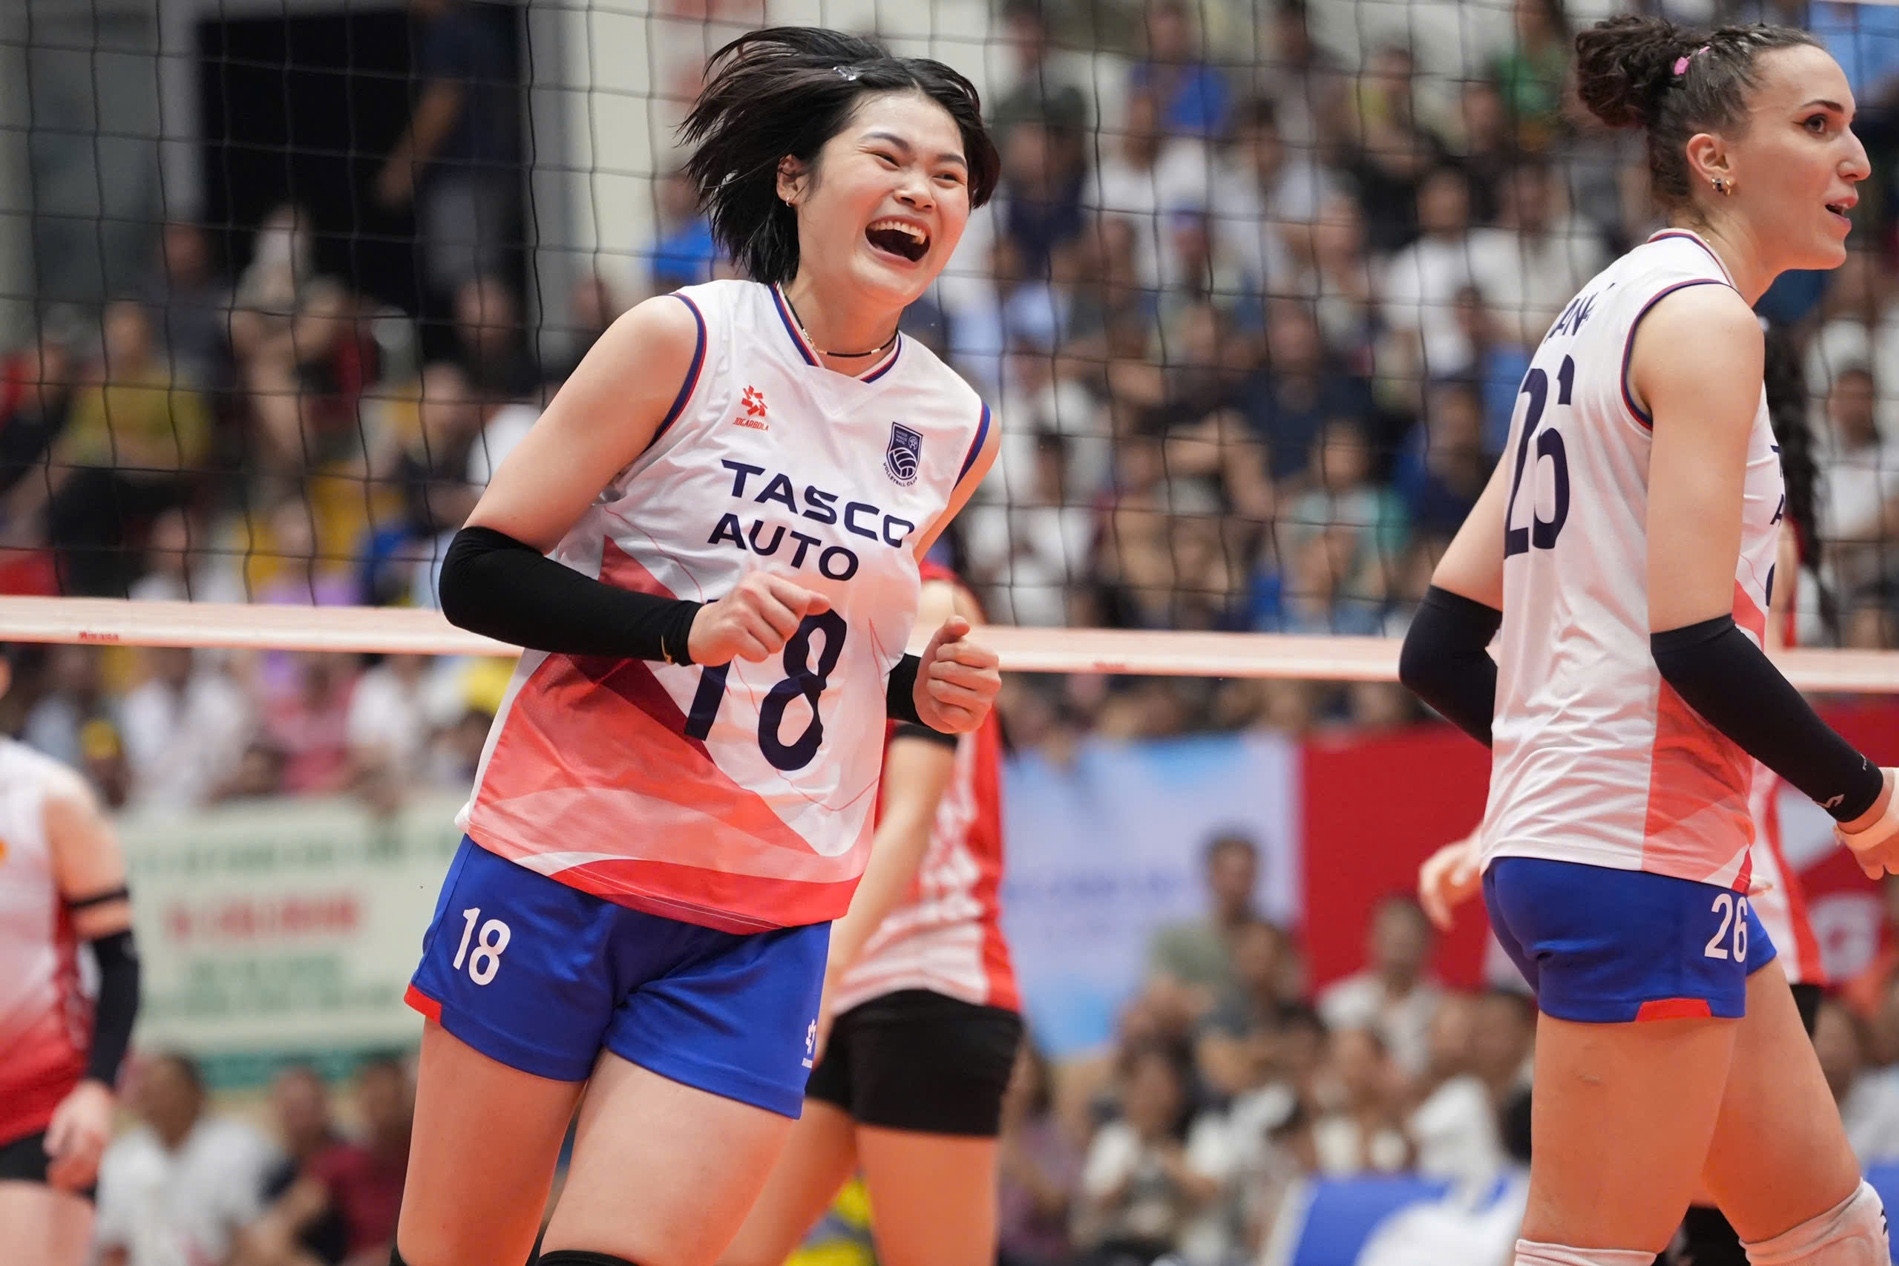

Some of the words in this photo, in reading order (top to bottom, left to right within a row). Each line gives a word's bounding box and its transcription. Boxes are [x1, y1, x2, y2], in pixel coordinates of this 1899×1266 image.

[1504, 354, 1575, 560] 26
[720, 459, 915, 549] TASCO
[707, 512, 859, 582] AUTO
[452, 907, 511, 986] 18
[1704, 893, 1748, 963] 26
